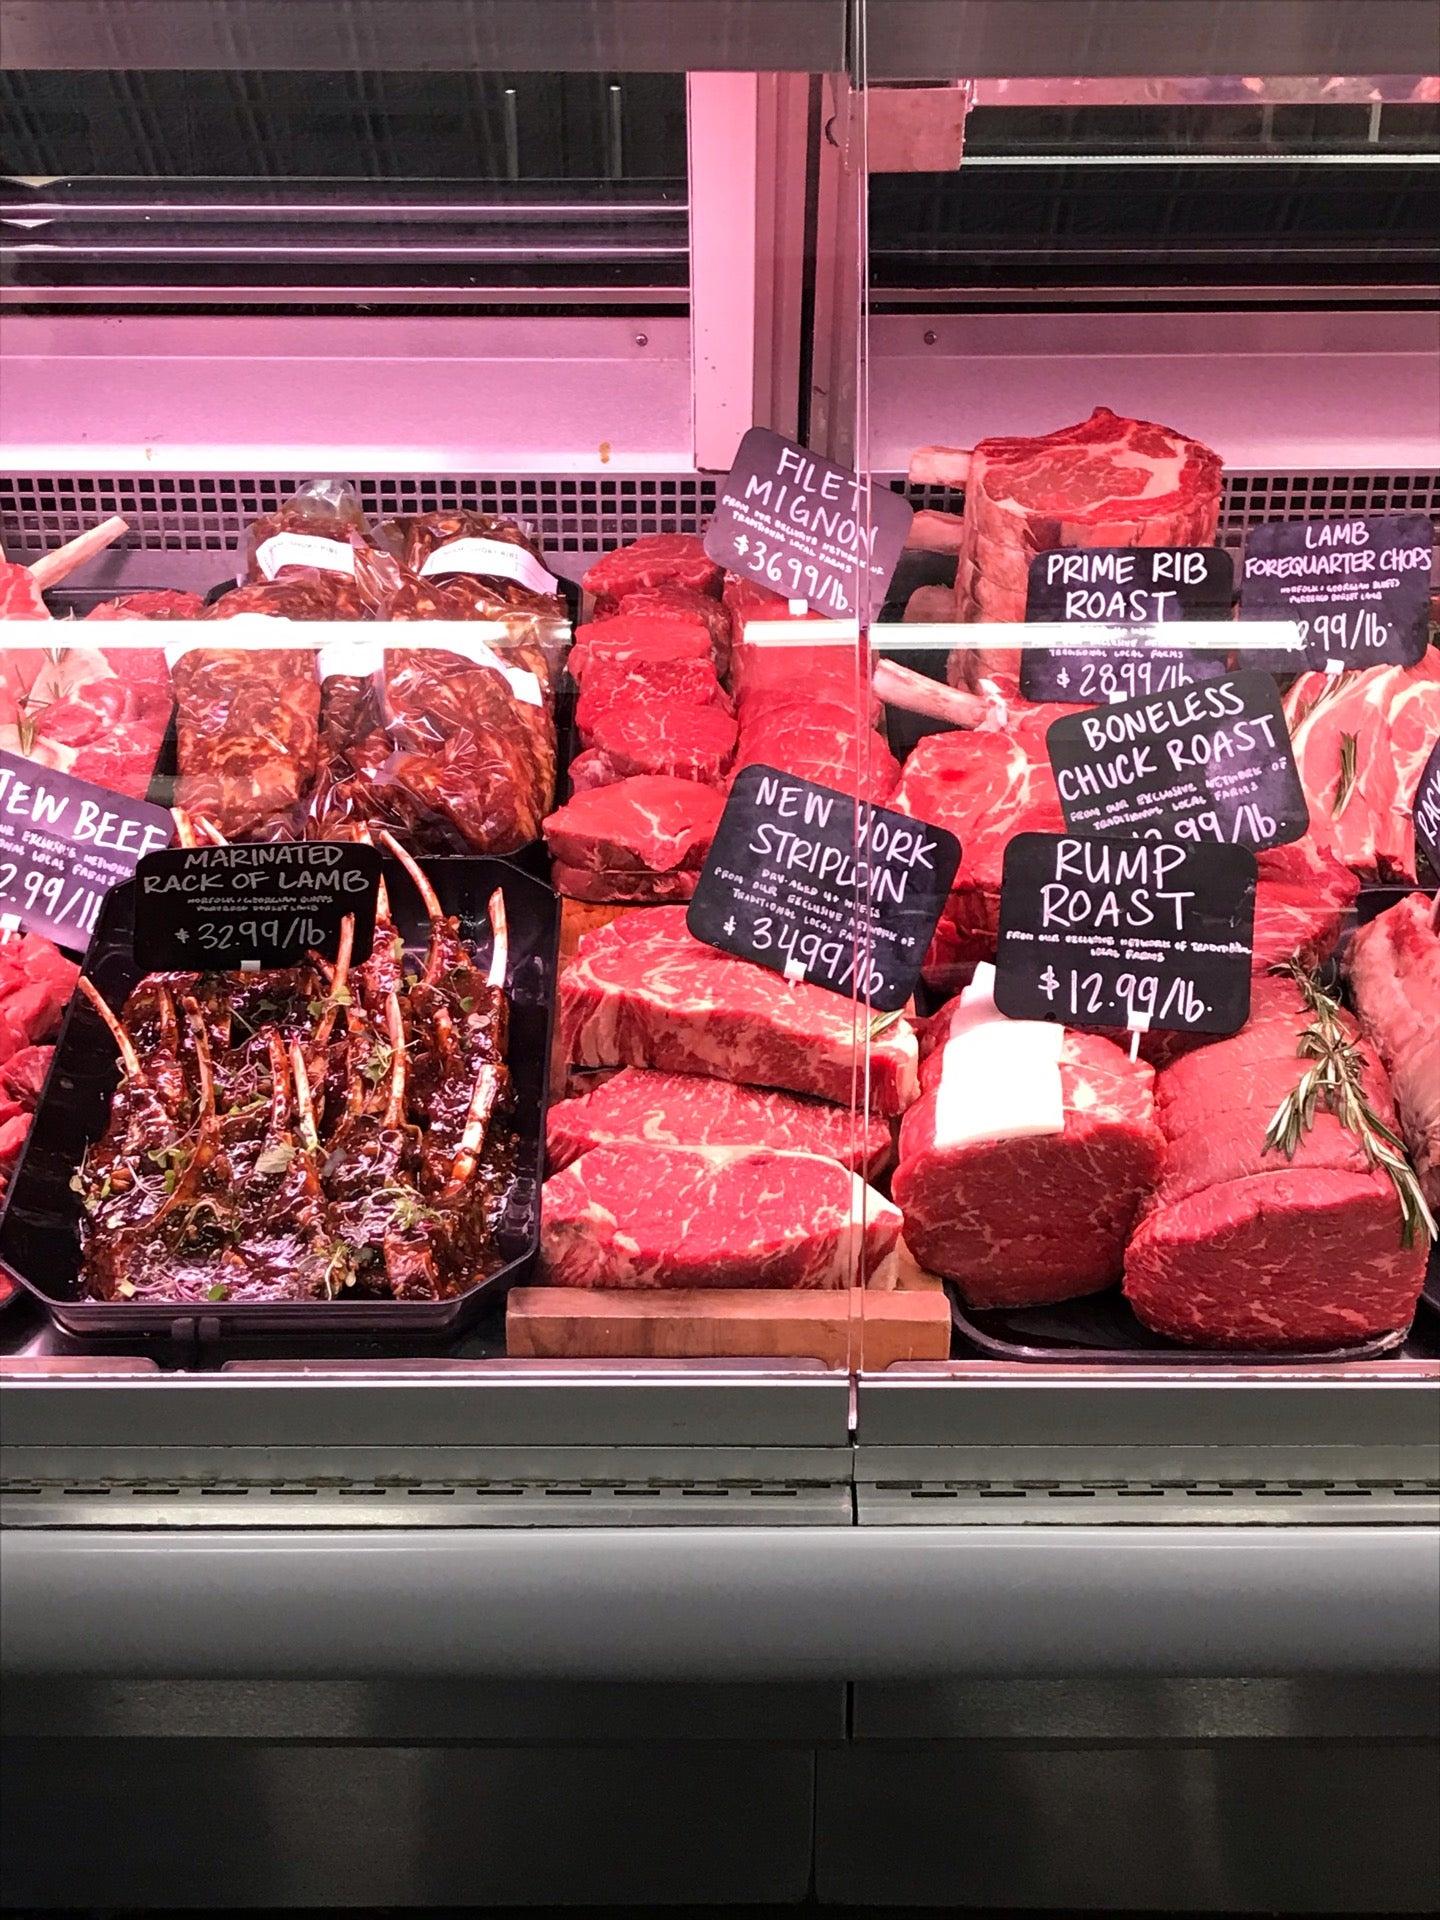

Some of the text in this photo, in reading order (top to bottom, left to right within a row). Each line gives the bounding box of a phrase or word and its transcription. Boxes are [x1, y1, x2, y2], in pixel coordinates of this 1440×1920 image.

[777, 447, 868, 511] FILET
[745, 474, 879, 555] MIGNON
[1305, 521, 1370, 549] LAMB
[789, 538, 816, 557] LOCAL
[1047, 552, 1208, 585] PRIME RIB
[1245, 547, 1432, 579] FOREQUARTER CHOPS
[1066, 589, 1177, 622] ROAST
[1082, 682, 1245, 752] BONELESS
[1058, 714, 1275, 801] CHUCK ROAST
[1070, 756, 1287, 822] FROM OUR EXCLUSIVE NETWORK OF
[1093, 781, 1258, 830] TRADITIONAL LOCAL FARMS
[72, 800, 167, 860] BEEF
[755, 776, 938, 870] NEW YORK
[32, 850, 65, 871] LOCAL
[72, 864, 117, 887] FARMS
[83, 855, 134, 878] NETWORK
[143, 870, 369, 894] RACK OF LAMB
[184, 846, 343, 869] MARINATED
[749, 823, 908, 903] STRIPLOIN
[1055, 839, 1187, 890] RUMP
[714, 866, 915, 948] FROM OUR EXCLUSIVE NETWORK OF
[732, 888, 877, 949] TRADITIONAL LOCAL FARMS
[1040, 884, 1196, 930] ROAST
[1006, 930, 1034, 940] FROM
[1174, 940, 1187, 952] OF
